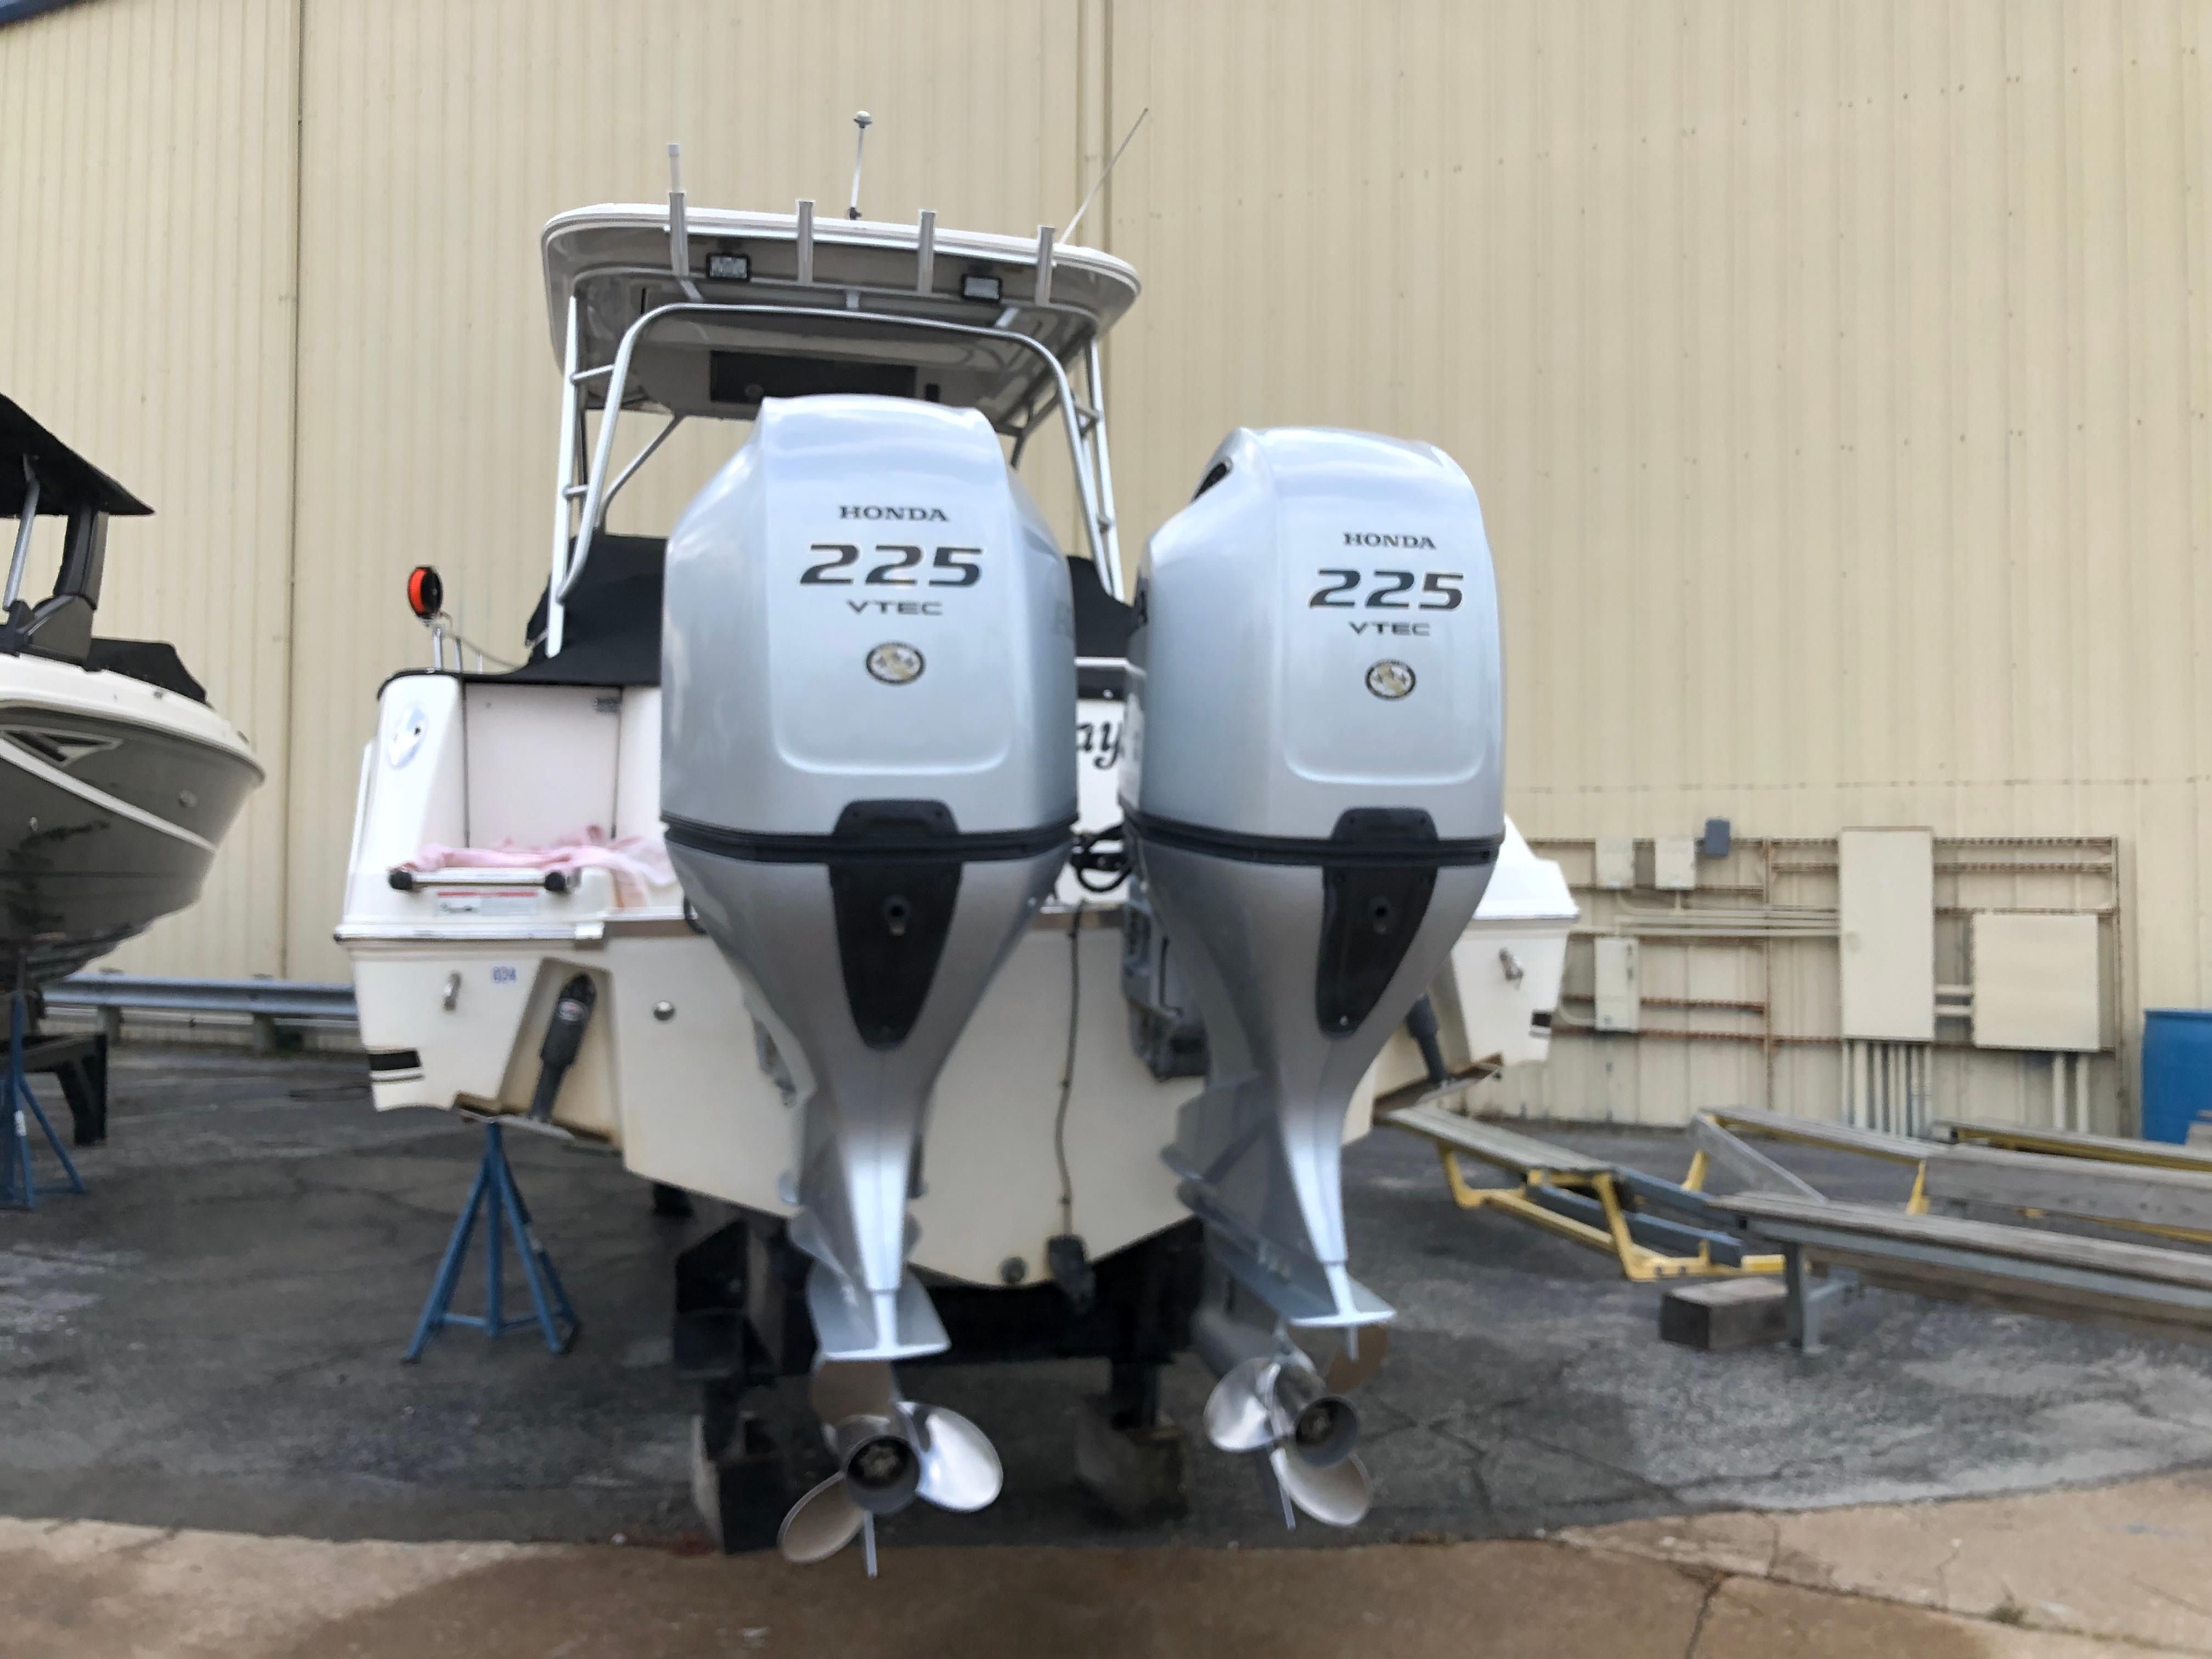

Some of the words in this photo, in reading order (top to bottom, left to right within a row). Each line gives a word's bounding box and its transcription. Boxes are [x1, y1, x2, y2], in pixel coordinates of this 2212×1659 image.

[839, 505, 950, 522] HONDA
[1344, 532, 1437, 549] HONDA
[800, 544, 983, 587] 225
[1308, 568, 1464, 611] 225
[847, 600, 943, 615] VTEC
[1348, 621, 1431, 636] VTEC
